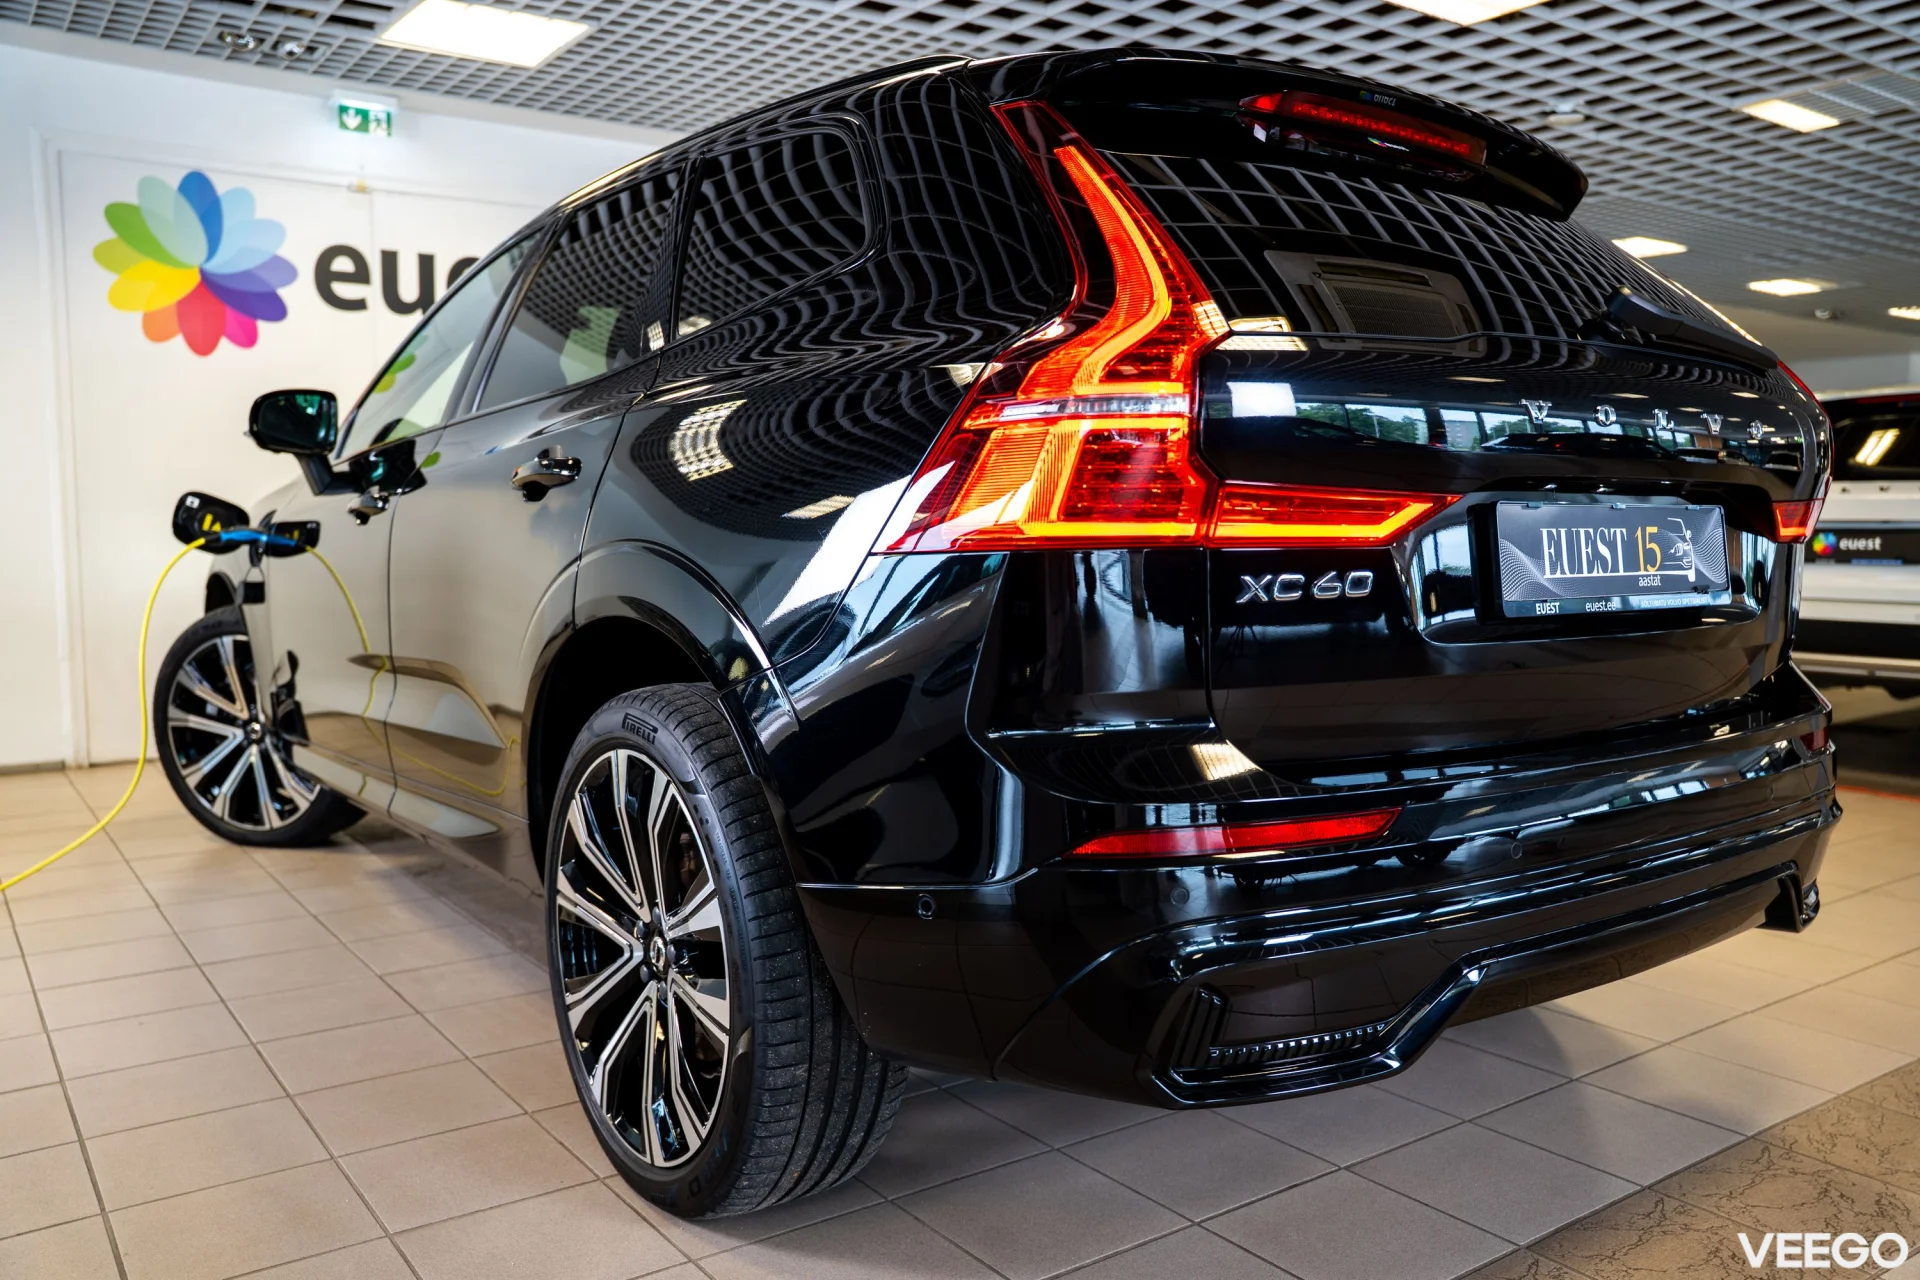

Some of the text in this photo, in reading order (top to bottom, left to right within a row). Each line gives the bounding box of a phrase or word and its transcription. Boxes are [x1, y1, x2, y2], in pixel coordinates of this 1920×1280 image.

[1519, 399, 1763, 439] VOLVO
[1540, 526, 1662, 576] EUEST 15
[1839, 536, 1881, 551] euest
[1638, 574, 1661, 586] aastat
[1535, 602, 1560, 615] EUEST
[1585, 600, 1616, 612] euest.ee
[621, 712, 659, 745] PIRELLI
